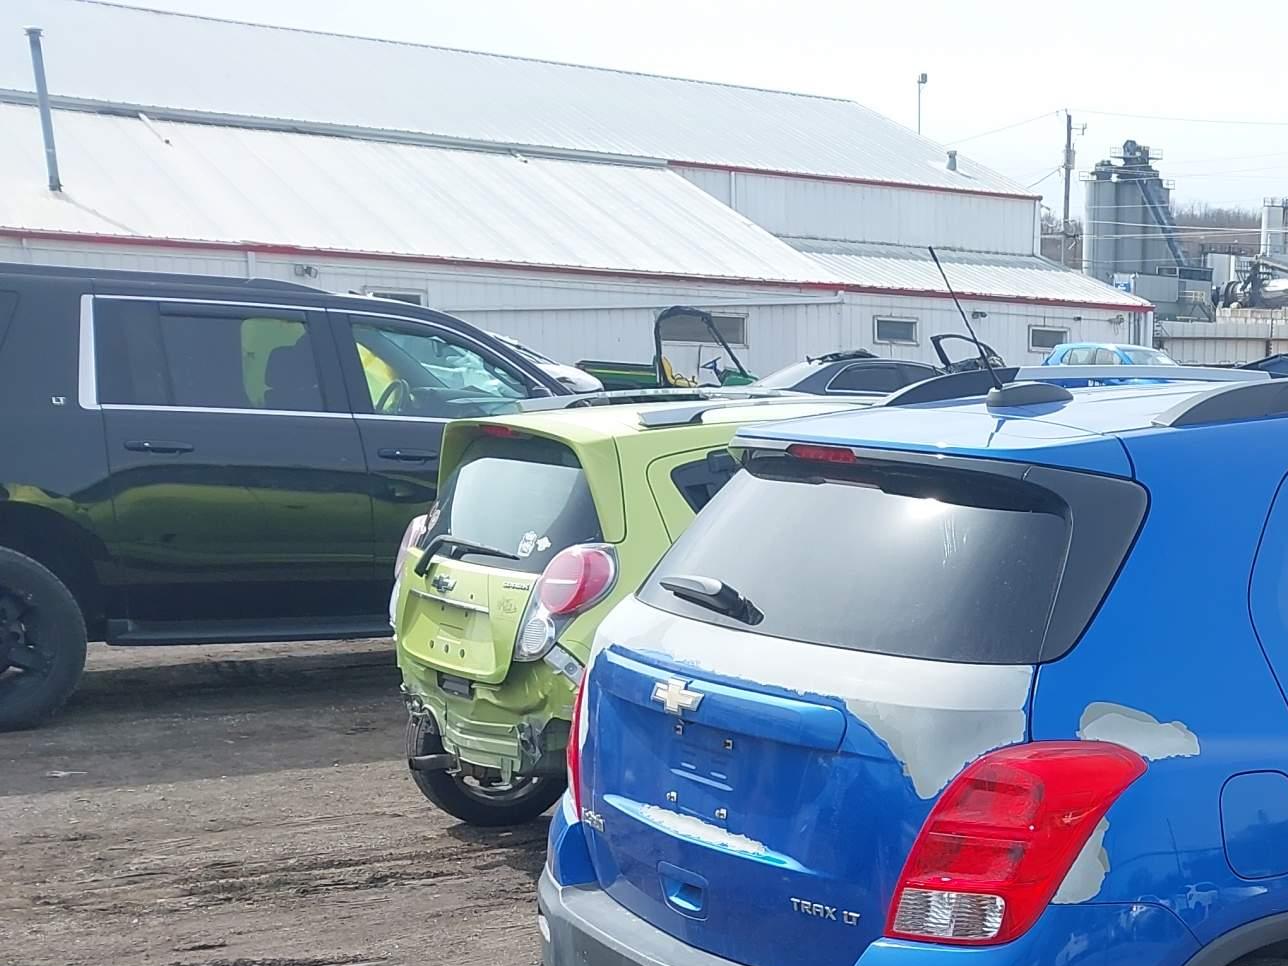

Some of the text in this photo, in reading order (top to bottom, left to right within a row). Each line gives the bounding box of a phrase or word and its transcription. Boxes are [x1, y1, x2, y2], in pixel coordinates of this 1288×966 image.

[51, 396, 66, 405] LT
[790, 897, 861, 926] TRAX LT
